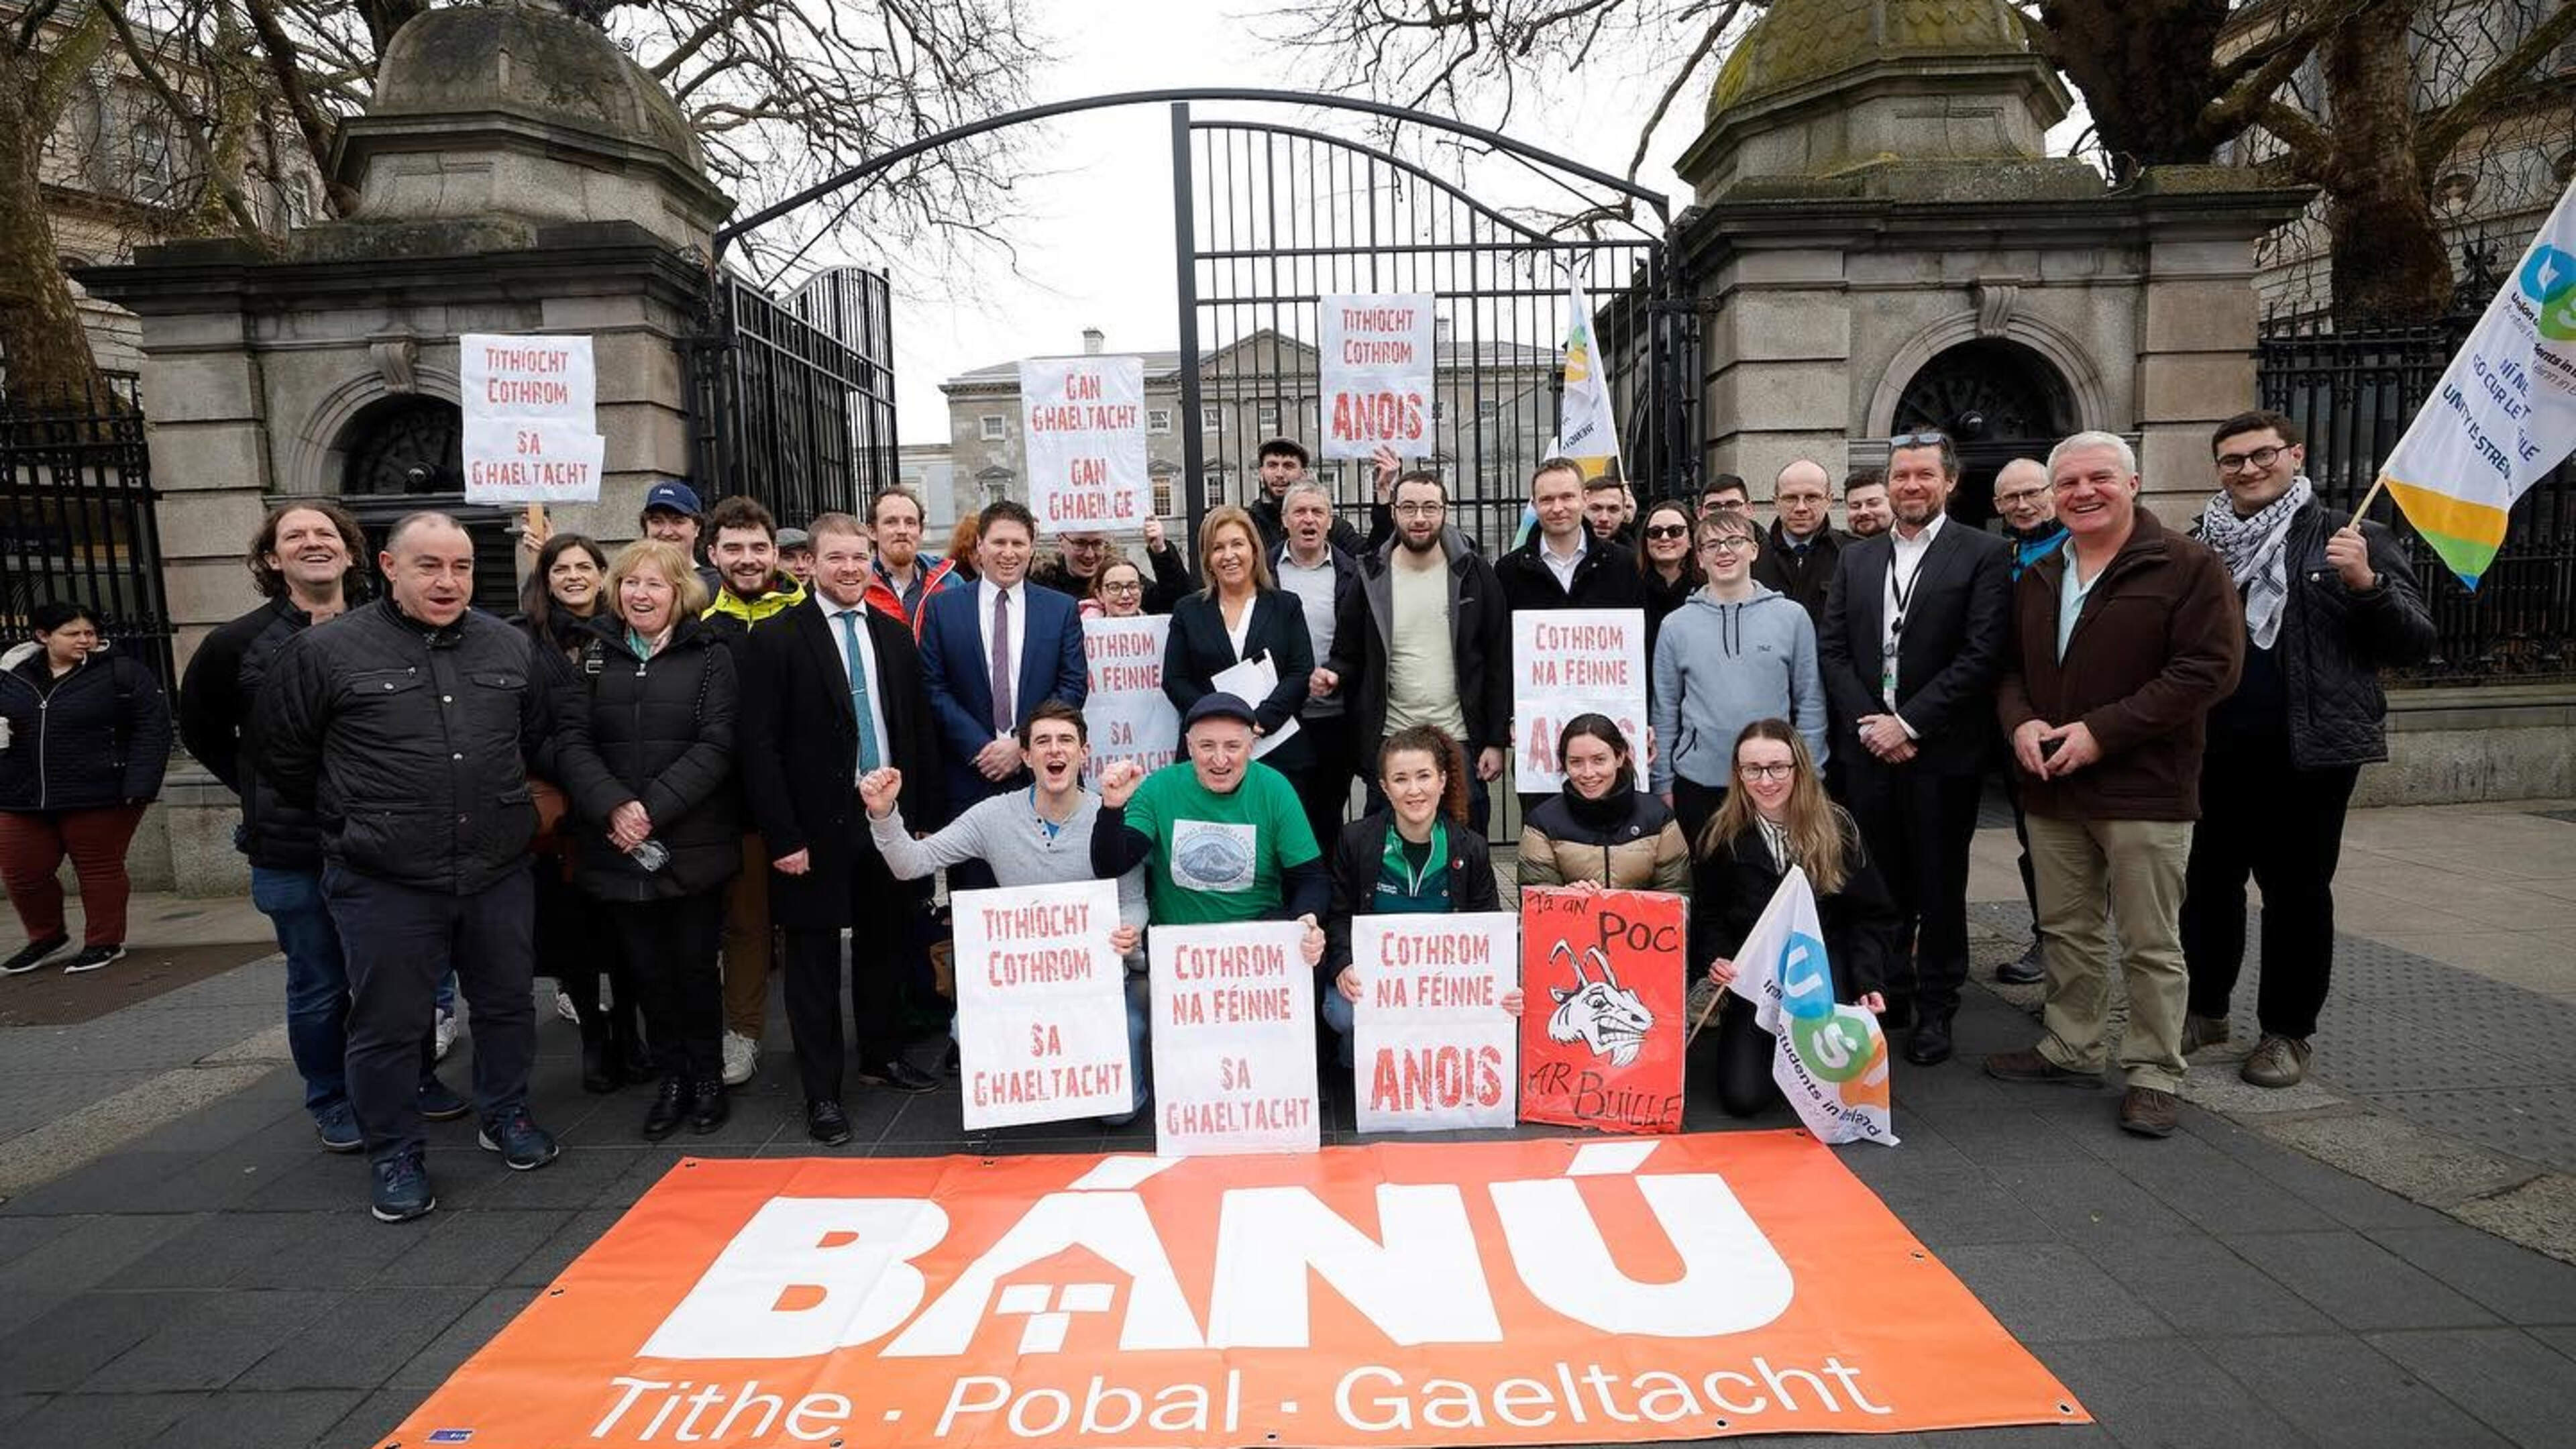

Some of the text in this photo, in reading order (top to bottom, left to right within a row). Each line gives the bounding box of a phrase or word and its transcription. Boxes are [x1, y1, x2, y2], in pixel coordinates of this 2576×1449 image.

[1343, 339, 1413, 364] COTHROM
[487, 377, 568, 405] COTHROM
[1065, 373, 1101, 401] GAN
[2484, 372, 2507, 404] CUR
[1032, 405, 1136, 432] GHAELTACHT
[1332, 392, 1424, 441] ANOIS
[517, 431, 541, 455] SA
[472, 461, 588, 486] GHAELTACHT
[1071, 458, 1106, 486] GAN
[1085, 633, 1155, 659] OTHROM
[1536, 623, 1624, 651] COTHROM
[1087, 669, 1095, 693] A
[1532, 660, 1557, 686] NA
[1110, 721, 1133, 746] SA
[1175, 943, 1285, 980] COTHROM
[1381, 931, 1491, 967] COTHROM
[988, 947, 1092, 987] COTHROM
[1173, 984, 1291, 1026] NA FÉINNE
[1377, 971, 1495, 1008] NA FÉINNE
[1030, 1022, 1062, 1057] SA
[973, 1063, 1123, 1108] GHAELTACHT
[1220, 1057, 1252, 1091] SA
[1369, 1044, 1503, 1112] ANOIS
[1527, 1062, 1572, 1095] AR
[1166, 1097, 1310, 1136] GHAELTACHT
[1822, 1099, 1840, 1116] in
[637, 1140, 1794, 1359] BÁNÚ
[588, 1355, 1894, 1442] Tithe Pobal Gaeltacht
